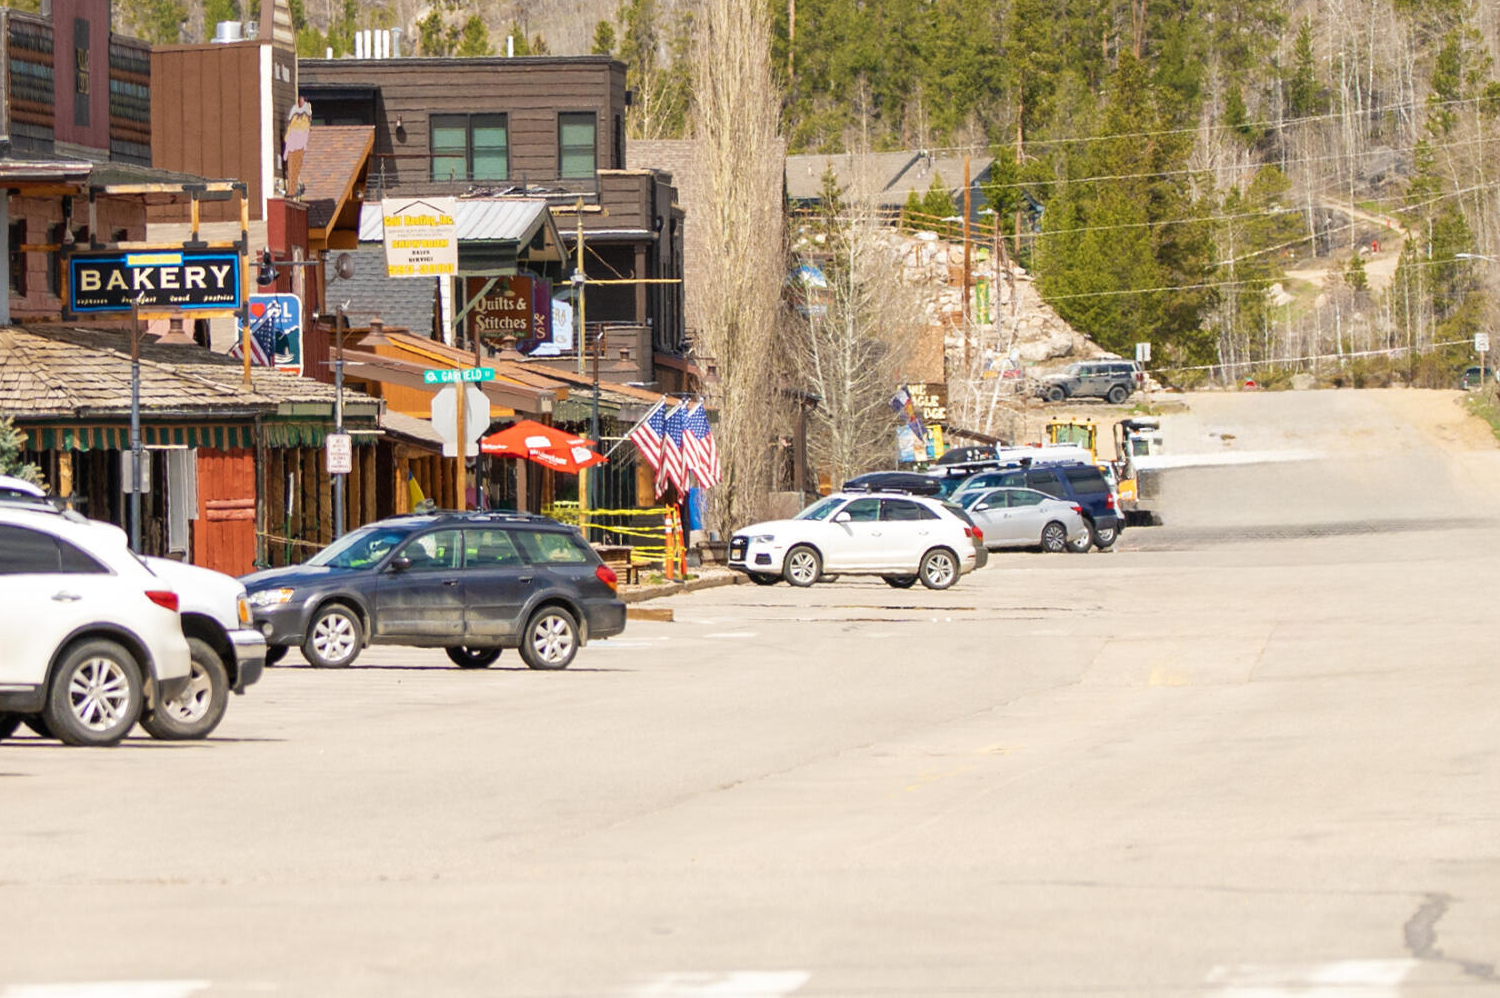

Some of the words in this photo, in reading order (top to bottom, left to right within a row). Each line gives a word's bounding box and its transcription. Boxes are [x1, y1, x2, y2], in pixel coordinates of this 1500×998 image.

[80, 265, 231, 292] BAKERY
[475, 296, 515, 314] Quilts
[516, 298, 527, 310] &
[475, 314, 527, 331] Stitches
[924, 407, 947, 419] DGE
